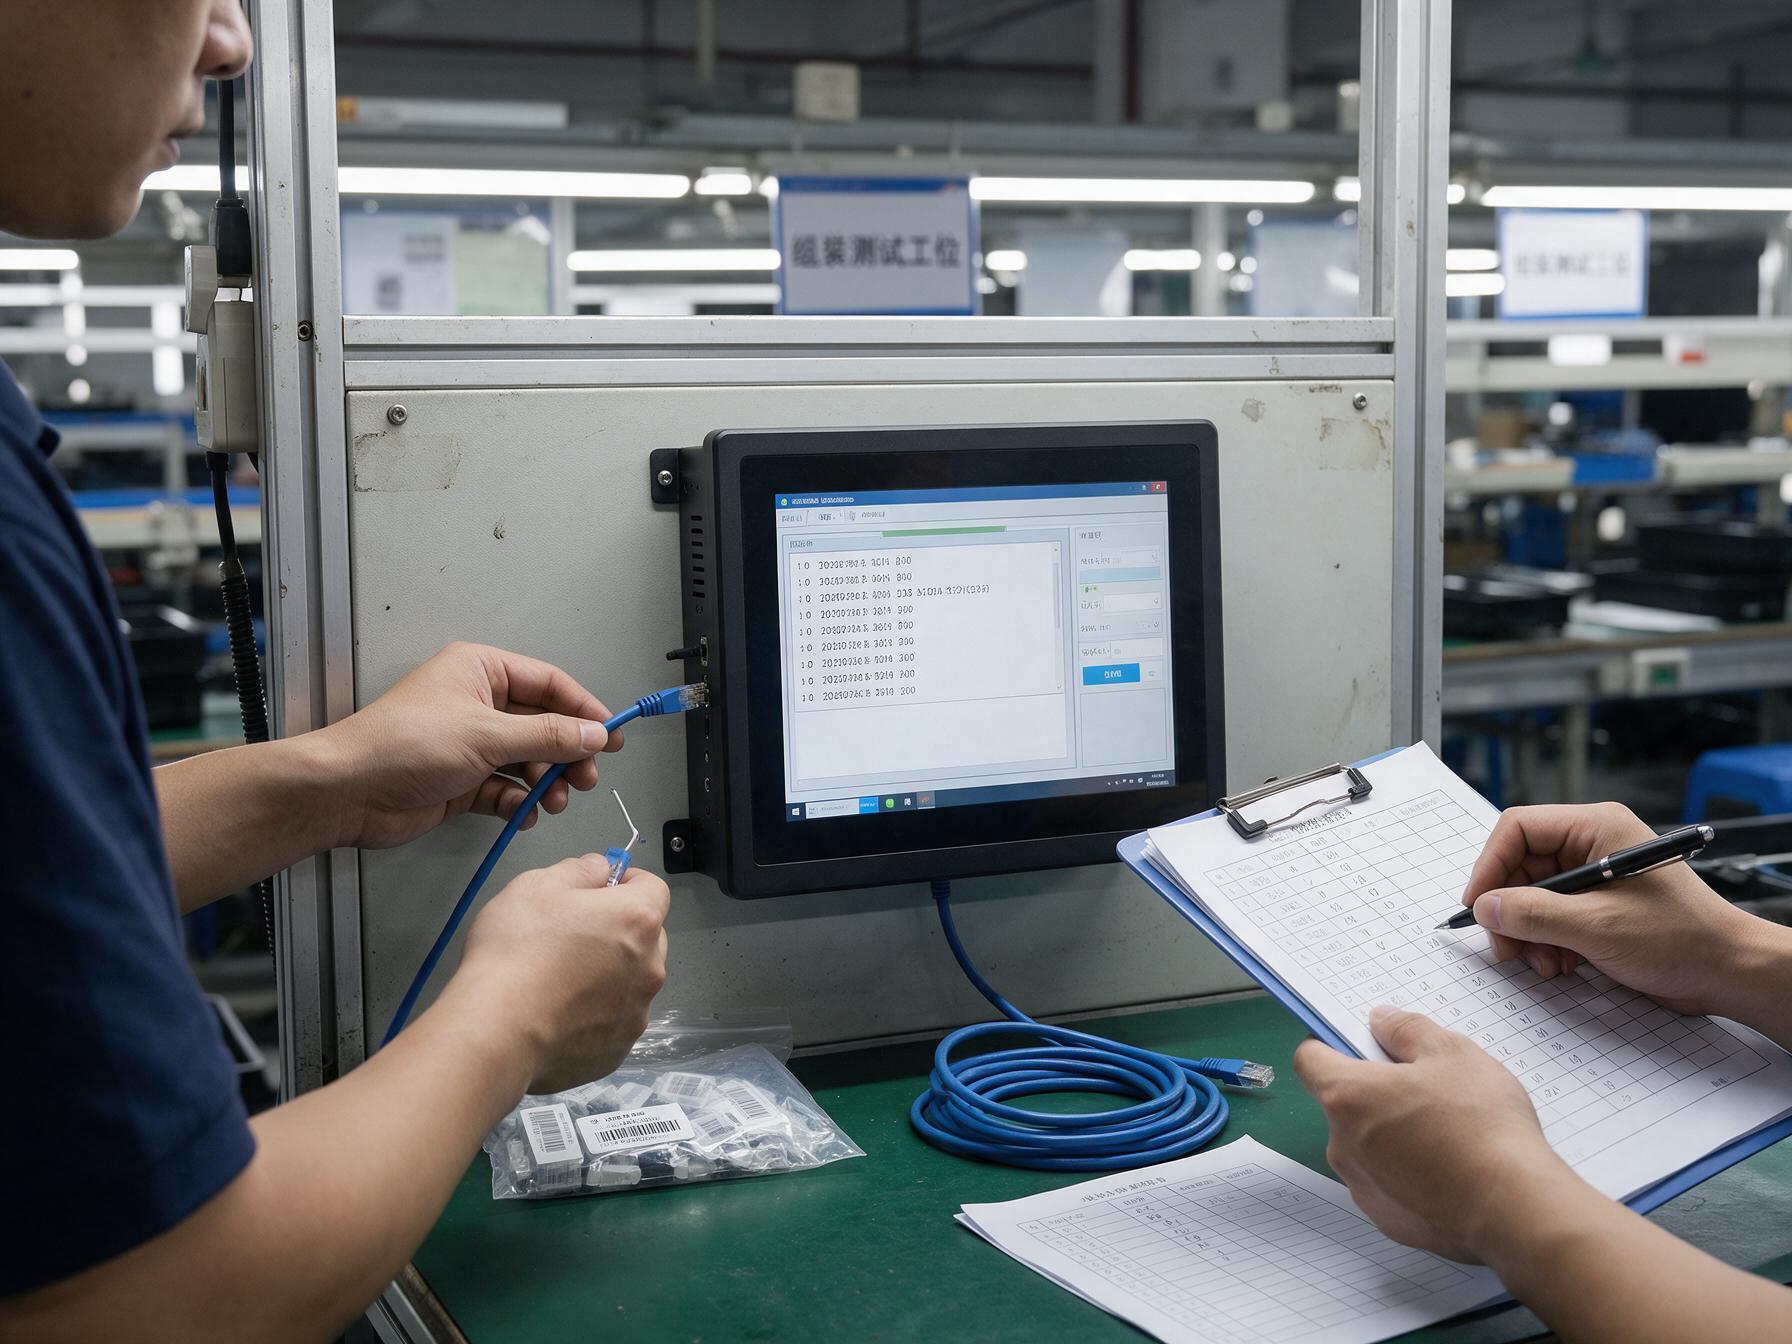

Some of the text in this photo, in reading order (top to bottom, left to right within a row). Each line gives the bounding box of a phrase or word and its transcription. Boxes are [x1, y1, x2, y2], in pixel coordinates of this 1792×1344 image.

[792, 234, 961, 268] 组装测试工位
